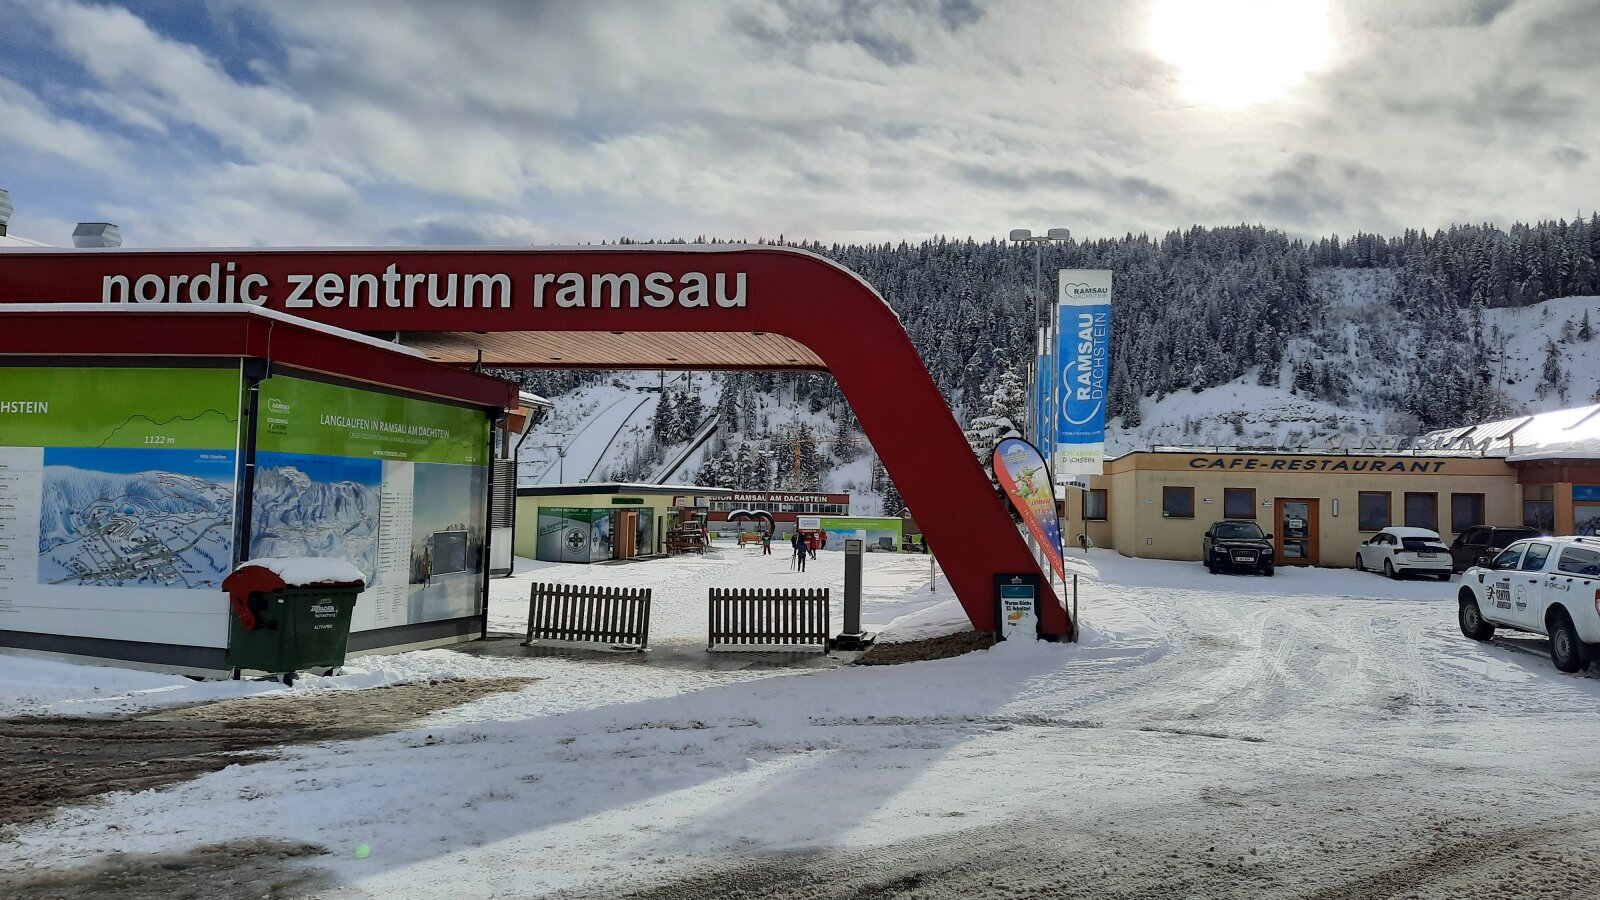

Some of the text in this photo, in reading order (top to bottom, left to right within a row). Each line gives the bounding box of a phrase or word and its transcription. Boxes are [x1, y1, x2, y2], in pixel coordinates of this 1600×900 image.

[101, 261, 748, 308] nordic zentrum ramsau
[1074, 287, 1108, 295] RAMSAU
[1077, 313, 1094, 400] RAMSAU
[1092, 312, 1107, 400] DACHSTEIN
[320, 413, 370, 429] LANGLAUFEN
[370, 420, 379, 431] IN
[379, 421, 407, 434] RAMSAU
[407, 425, 418, 436] AM
[418, 425, 450, 439] DACHSTEIN
[143, 435, 175, 445] 1122 m
[1189, 456, 1446, 473] CAFE-RESTAURANT
[783, 495, 828, 503] DACHSTEIN
